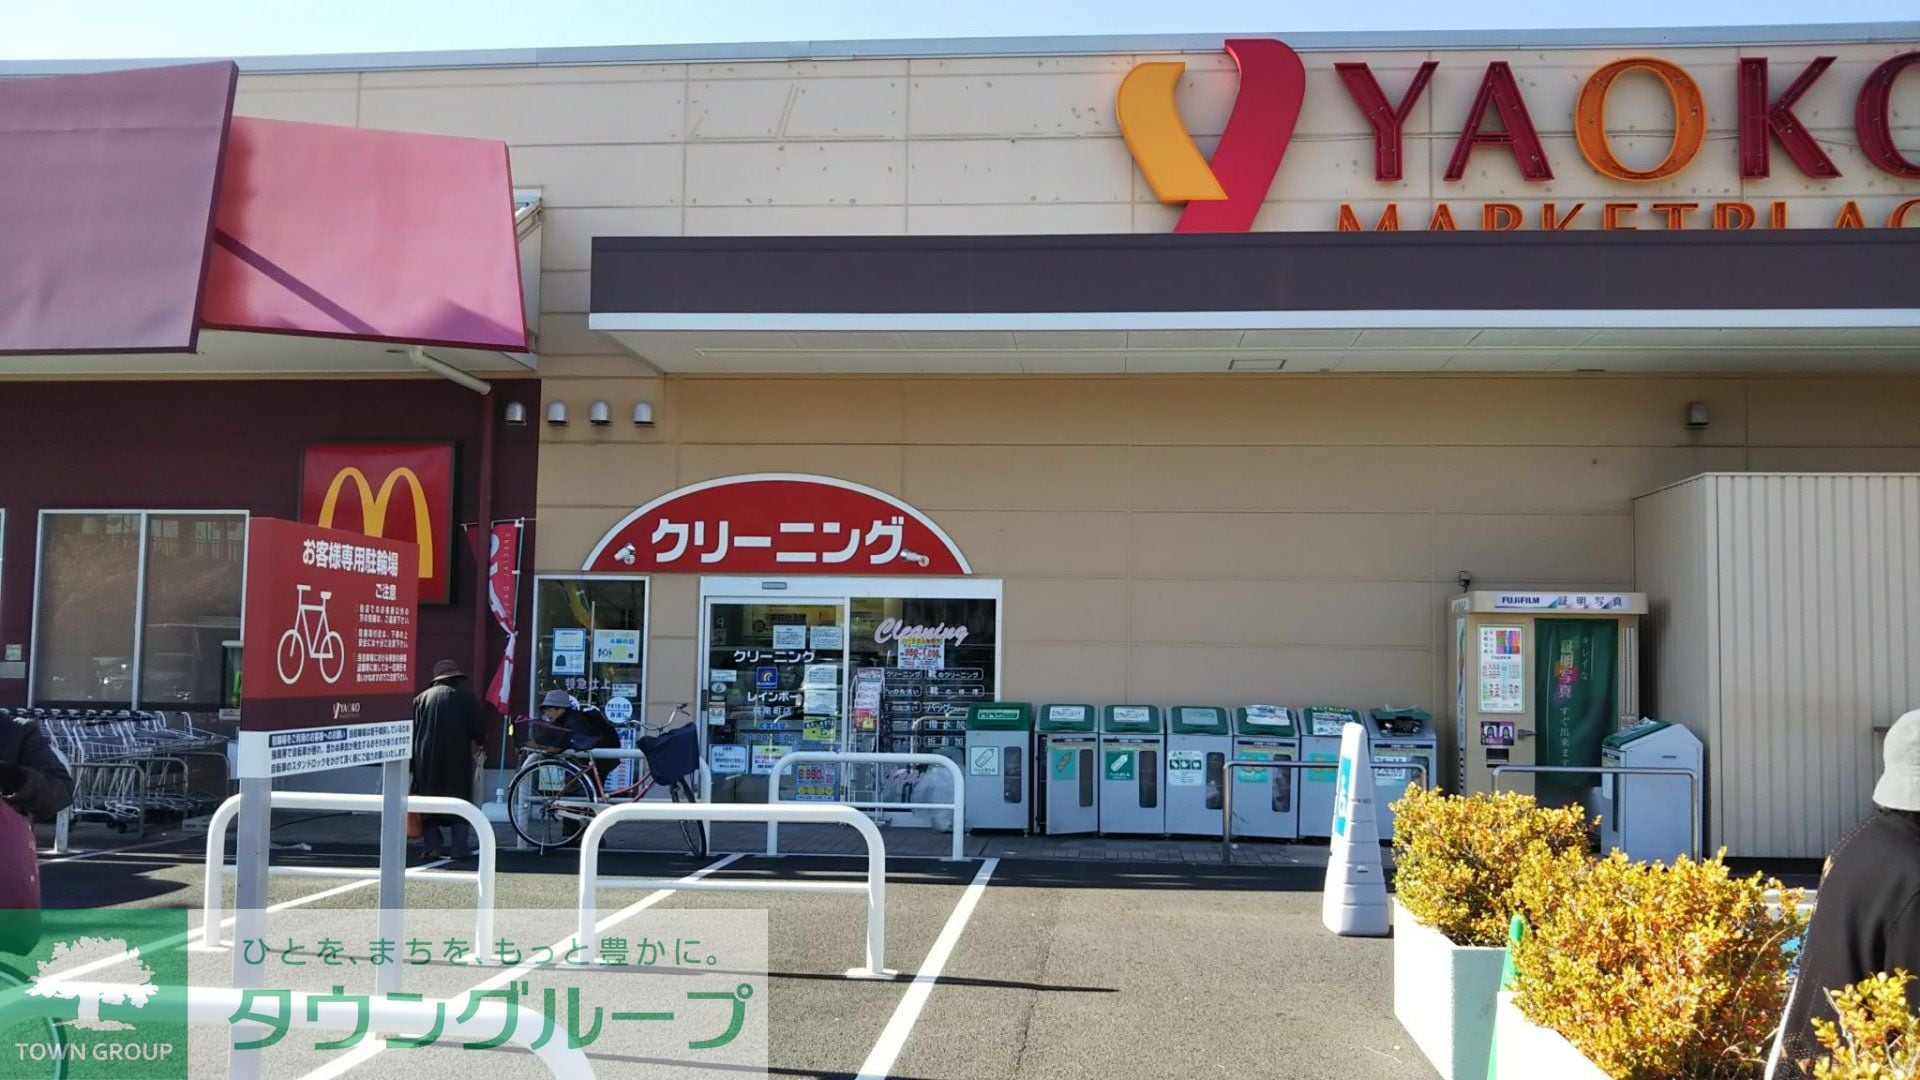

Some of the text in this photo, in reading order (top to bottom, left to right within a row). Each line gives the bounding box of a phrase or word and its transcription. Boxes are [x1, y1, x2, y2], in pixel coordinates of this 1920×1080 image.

[651, 516, 904, 565] クリーニング
[302, 539, 399, 577] お客様専用駐輪場
[375, 583, 397, 601] ご注意
[1558, 595, 1622, 607] 証明写真
[874, 617, 969, 647] Cleaning
[734, 650, 815, 663] クリーニング
